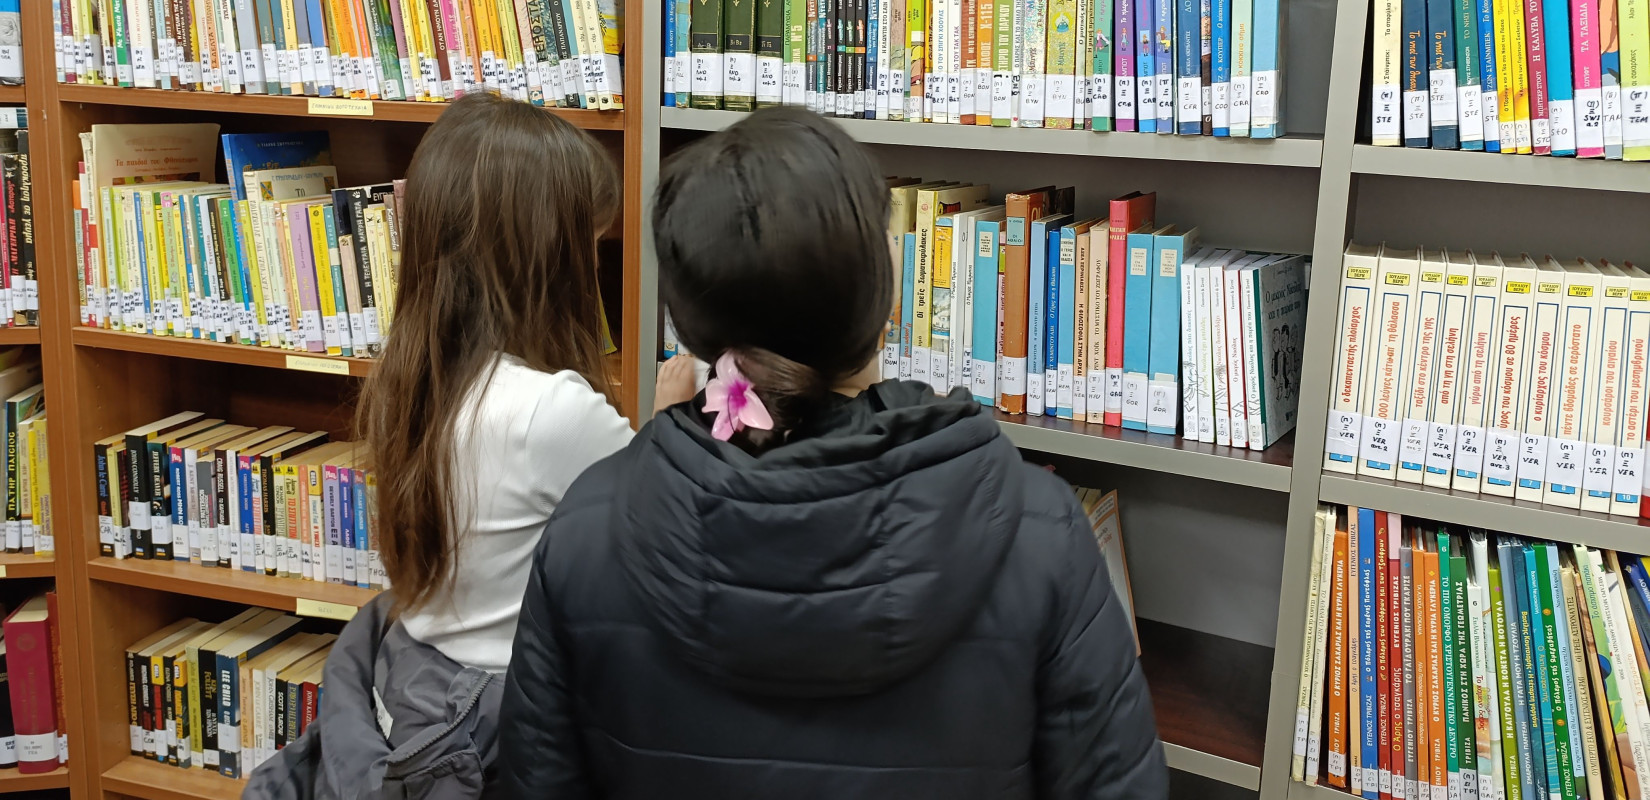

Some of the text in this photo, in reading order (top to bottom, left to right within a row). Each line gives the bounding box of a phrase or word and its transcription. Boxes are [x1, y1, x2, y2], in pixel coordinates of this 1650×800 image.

[1531, 16, 1540, 50] ΚΑΛΥΒΑ
[1581, 40, 1589, 53] ΤΑ
[1422, 332, 1433, 344] της
[1445, 328, 1459, 353] σελήνη
[1473, 332, 1487, 358] σελήνη
[1537, 331, 1551, 359] κόσμου
[1417, 346, 1430, 371] κέντρο
[1445, 355, 1456, 369] στη
[1538, 361, 1547, 374] του
[1630, 338, 1644, 388] μεσημβρινού
[1418, 373, 1426, 385] στο
[1471, 370, 1482, 384] από
[1497, 316, 1520, 429] ύρος του κόσμου σε 80 ημέρες
[1561, 324, 1581, 435] πέντε βδομάδες σε αερόστατο
[1606, 371, 1615, 384] του
[1440, 390, 1450, 404] από
[1470, 386, 1481, 405] γύρω
[1533, 376, 1548, 415] κυρίαρχος
[1601, 386, 1615, 426] κουρσάροι
[1630, 390, 1640, 403] του
[1626, 405, 1640, 431] αστέρι
[1455, 581, 1465, 628] ΓΕΩΜΕΤΡΙΑΣ
[1496, 600, 1505, 640] ΚΟΤΟΥΛΑ
[1457, 630, 1466, 645] ΤΗΣ
[1459, 647, 1467, 669] ΧΩΡΑ
[1499, 650, 1509, 680] ΚΟΚΕΤΑ
[222, 670, 231, 707] LEE CHILD
[1461, 688, 1470, 723] ΠΑΝΙΚΟΣ
